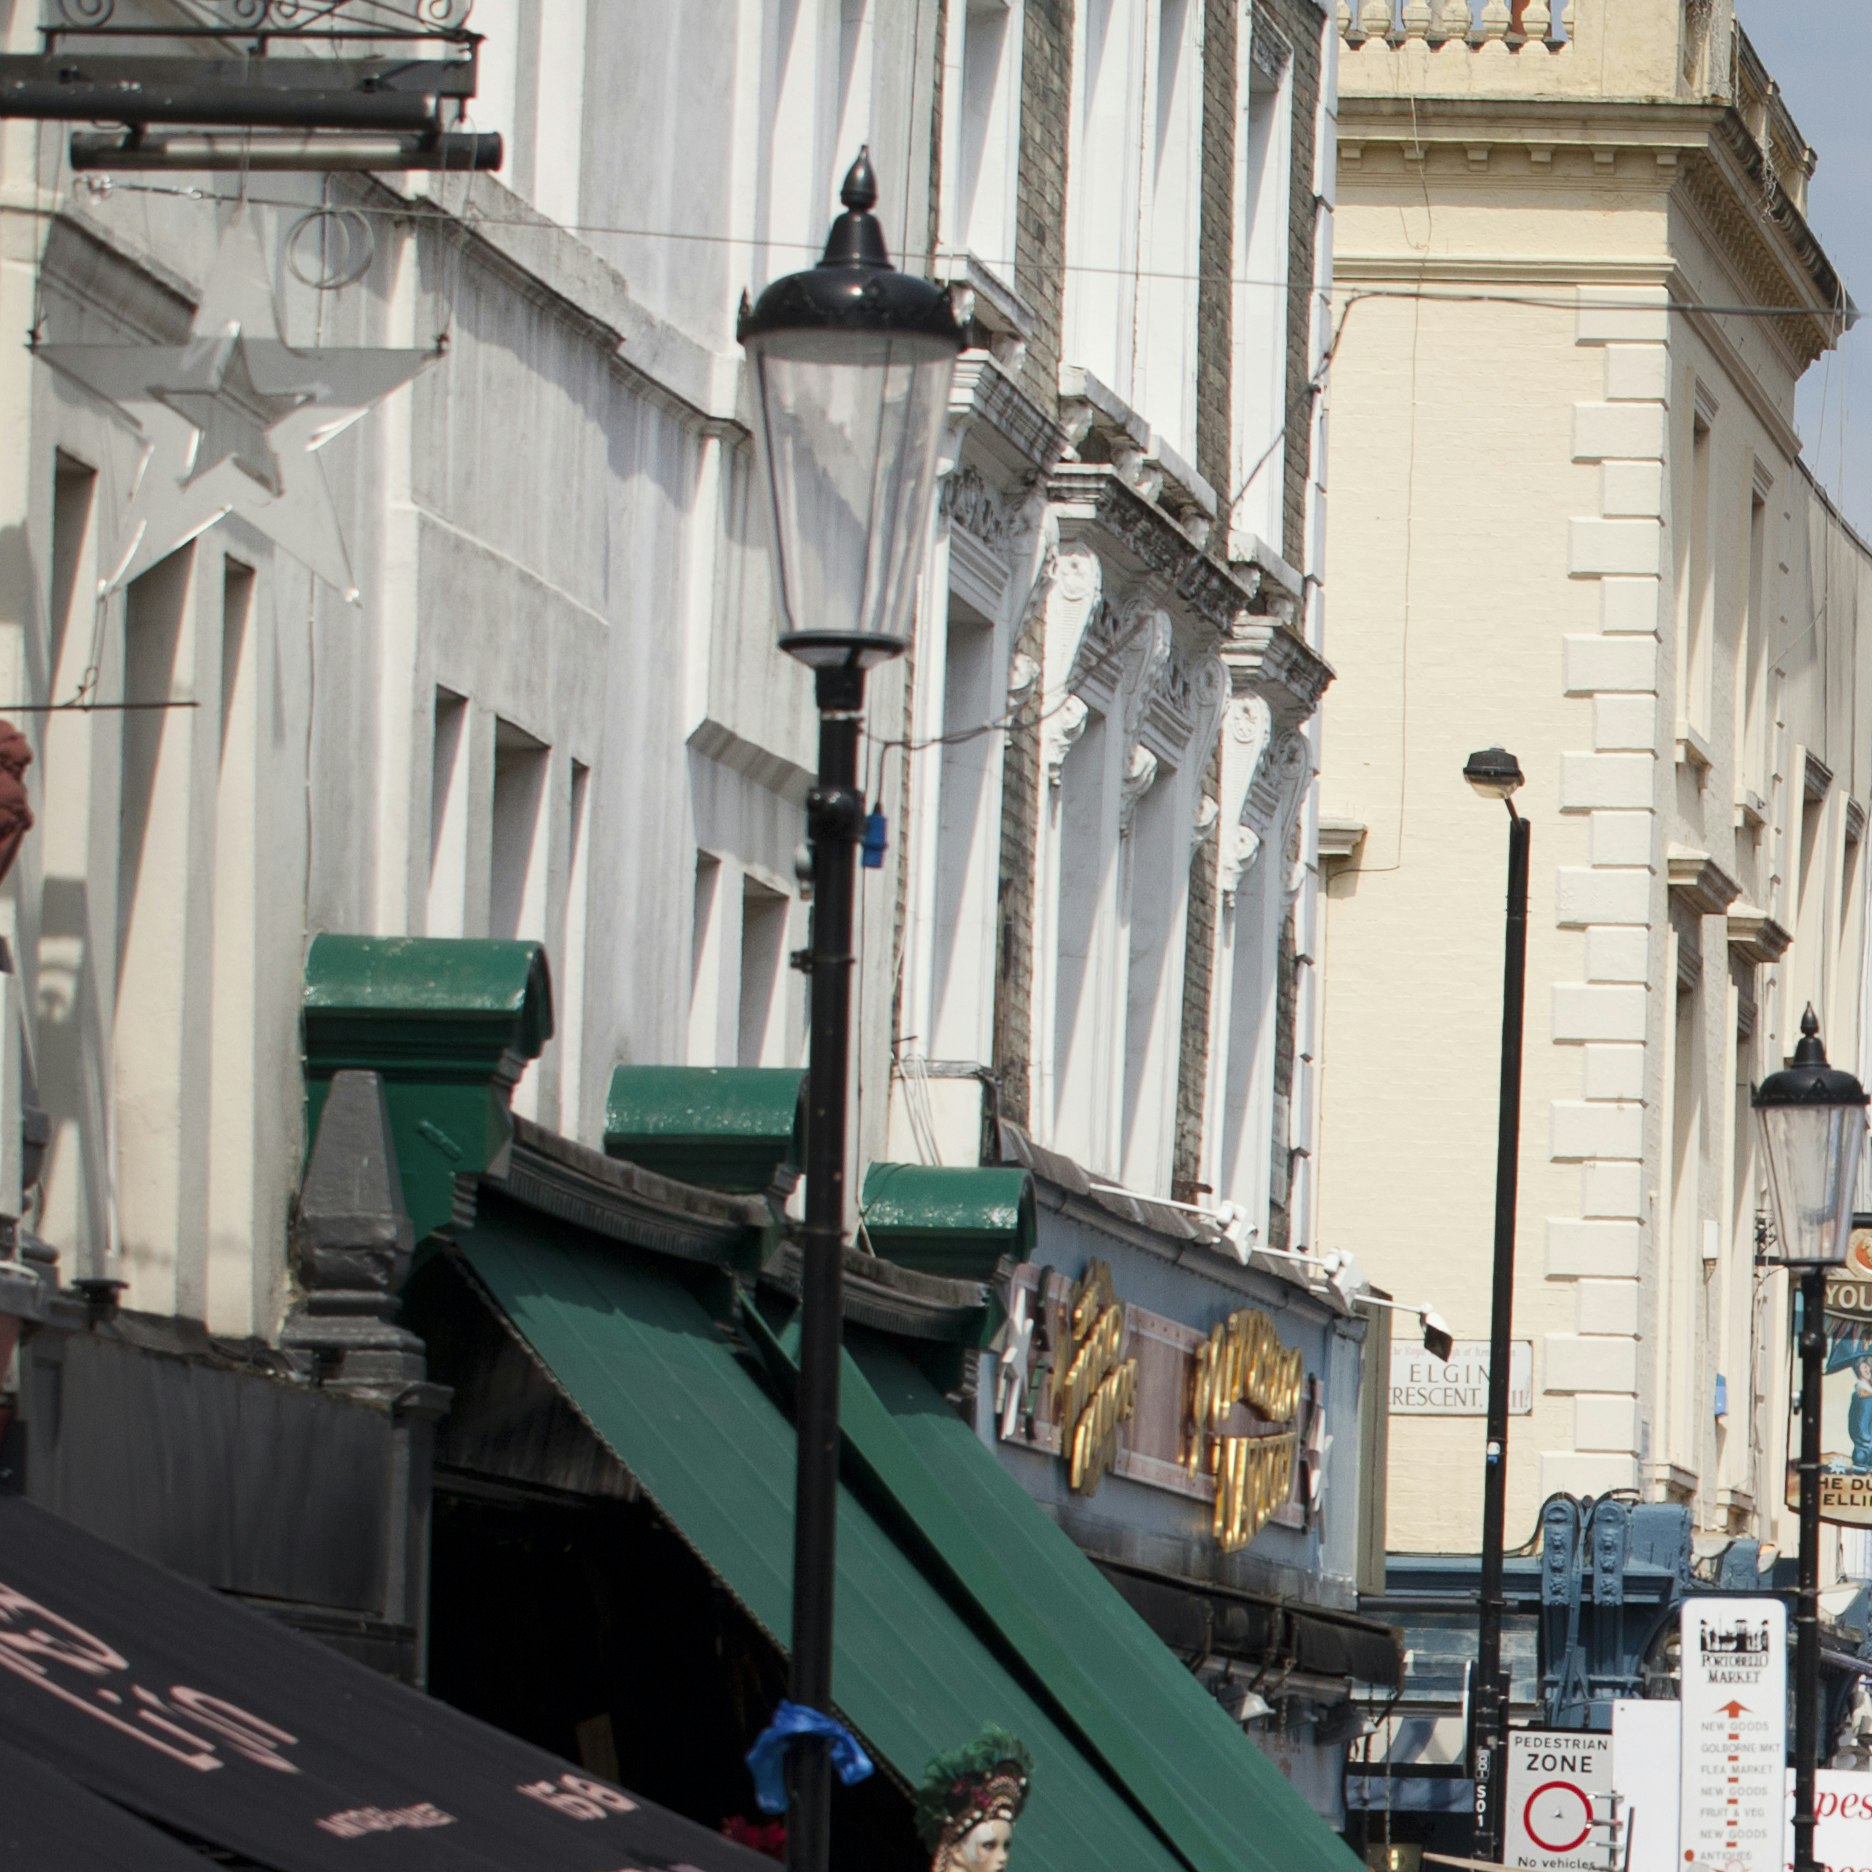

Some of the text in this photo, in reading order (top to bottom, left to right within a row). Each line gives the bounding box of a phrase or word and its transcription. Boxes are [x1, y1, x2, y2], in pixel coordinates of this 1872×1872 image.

[1389, 1387, 1483, 1408] RESCENT.
[1819, 1478, 1843, 1491] HE
[1702, 1655, 1768, 1667] PORTOBELLO
[1708, 1671, 1760, 1683] MARKET
[1701, 1722, 1769, 1731] NEW GOODS
[1515, 1736, 1608, 1750] PEDESTRIAN
[1527, 1754, 1593, 1773] ZONE
[1701, 1765, 1773, 1774] FLEA MARKET
[1701, 1787, 1768, 1796] NEW GOODS
[1701, 1808, 1728, 1817] FRUIT
[1745, 1808, 1764, 1817] VEG
[1700, 1830, 1767, 1839] NEW GOODS
[1518, 1857, 1595, 1870] No vehicles
